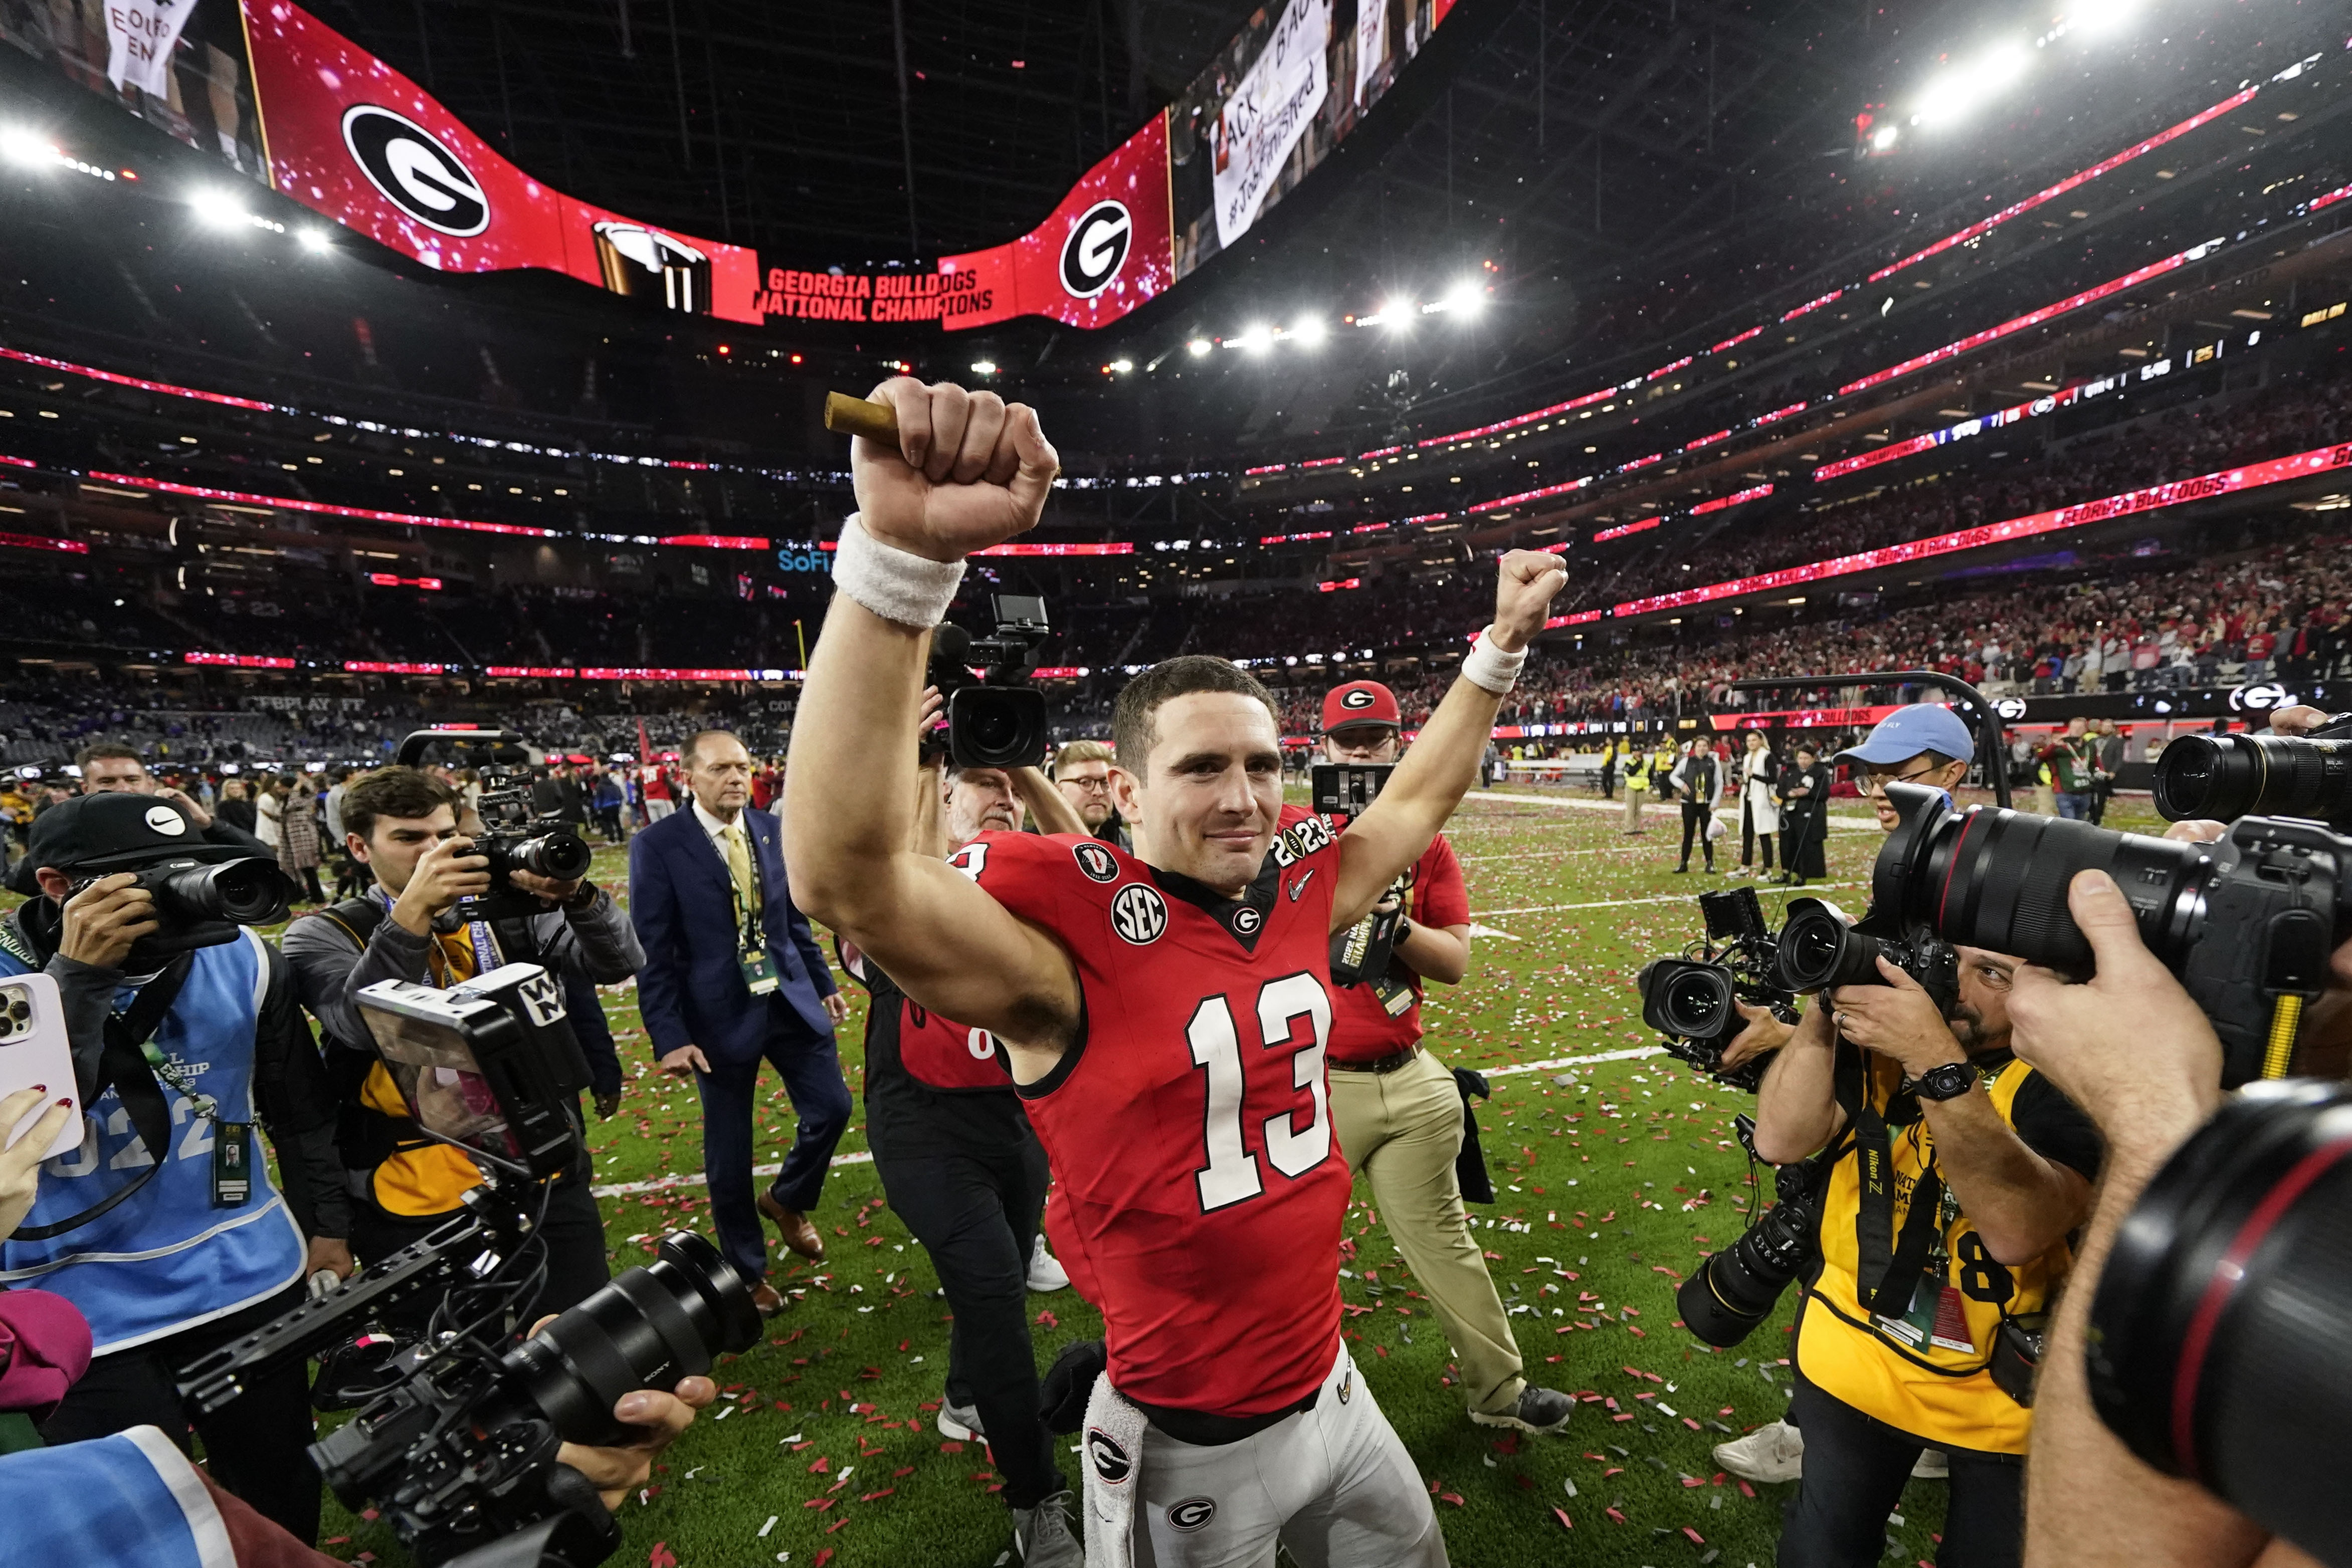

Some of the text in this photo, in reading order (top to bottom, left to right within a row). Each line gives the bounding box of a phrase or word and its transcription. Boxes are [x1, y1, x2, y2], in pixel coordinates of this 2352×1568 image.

[768, 268, 976, 298] GEORGIA BULLDOGS
[753, 290, 993, 322] NATIONAL CHAMPIONS
[2195, 345, 2214, 363] 25
[2062, 474, 2228, 524] GEORGIA BULLDOGS
[778, 549, 829, 572] SoFi
[1115, 887, 1164, 940] SEC
[1184, 969, 1333, 1215] 13
[1868, 1148, 1882, 1195] Nikon Z
[644, 1360, 670, 1383] SONY
